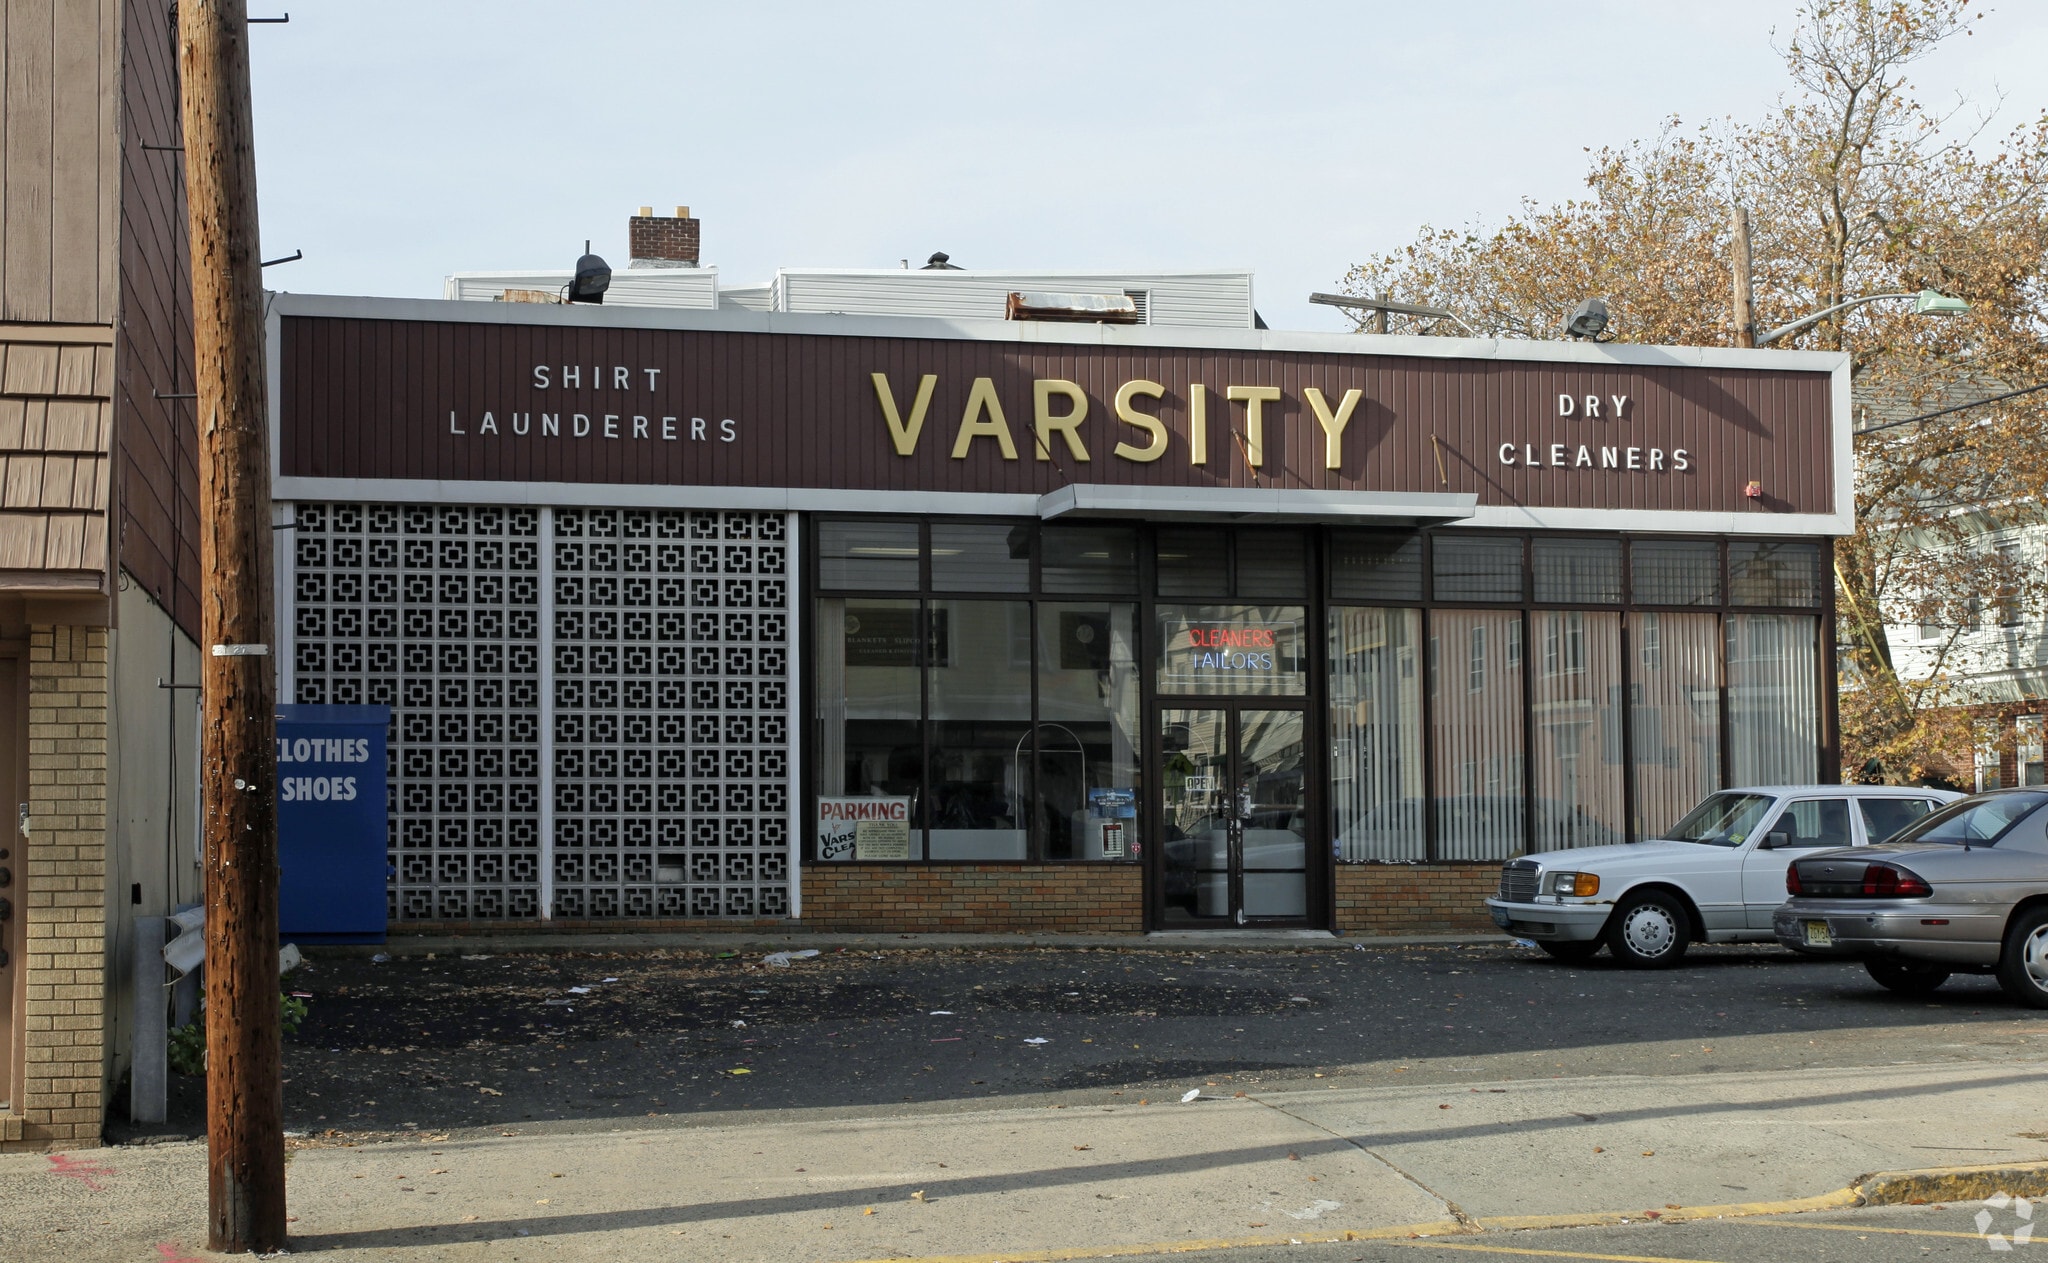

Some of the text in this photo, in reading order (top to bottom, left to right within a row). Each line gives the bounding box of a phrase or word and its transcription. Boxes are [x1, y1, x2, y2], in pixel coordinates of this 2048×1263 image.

[533, 365, 663, 392] SHIRT
[1558, 393, 1629, 418] DRY
[449, 410, 738, 443] LAUNDERERS
[870, 372, 1364, 470] VARSITY
[1498, 442, 1690, 471] CLEANERS
[1189, 629, 1275, 647] CLEANERS
[1193, 652, 1272, 670] TAILORS
[281, 776, 357, 801] SHOES
[1187, 777, 1213, 789] OPEN
[820, 802, 905, 820] PARKING
[820, 832, 856, 847] VARS
